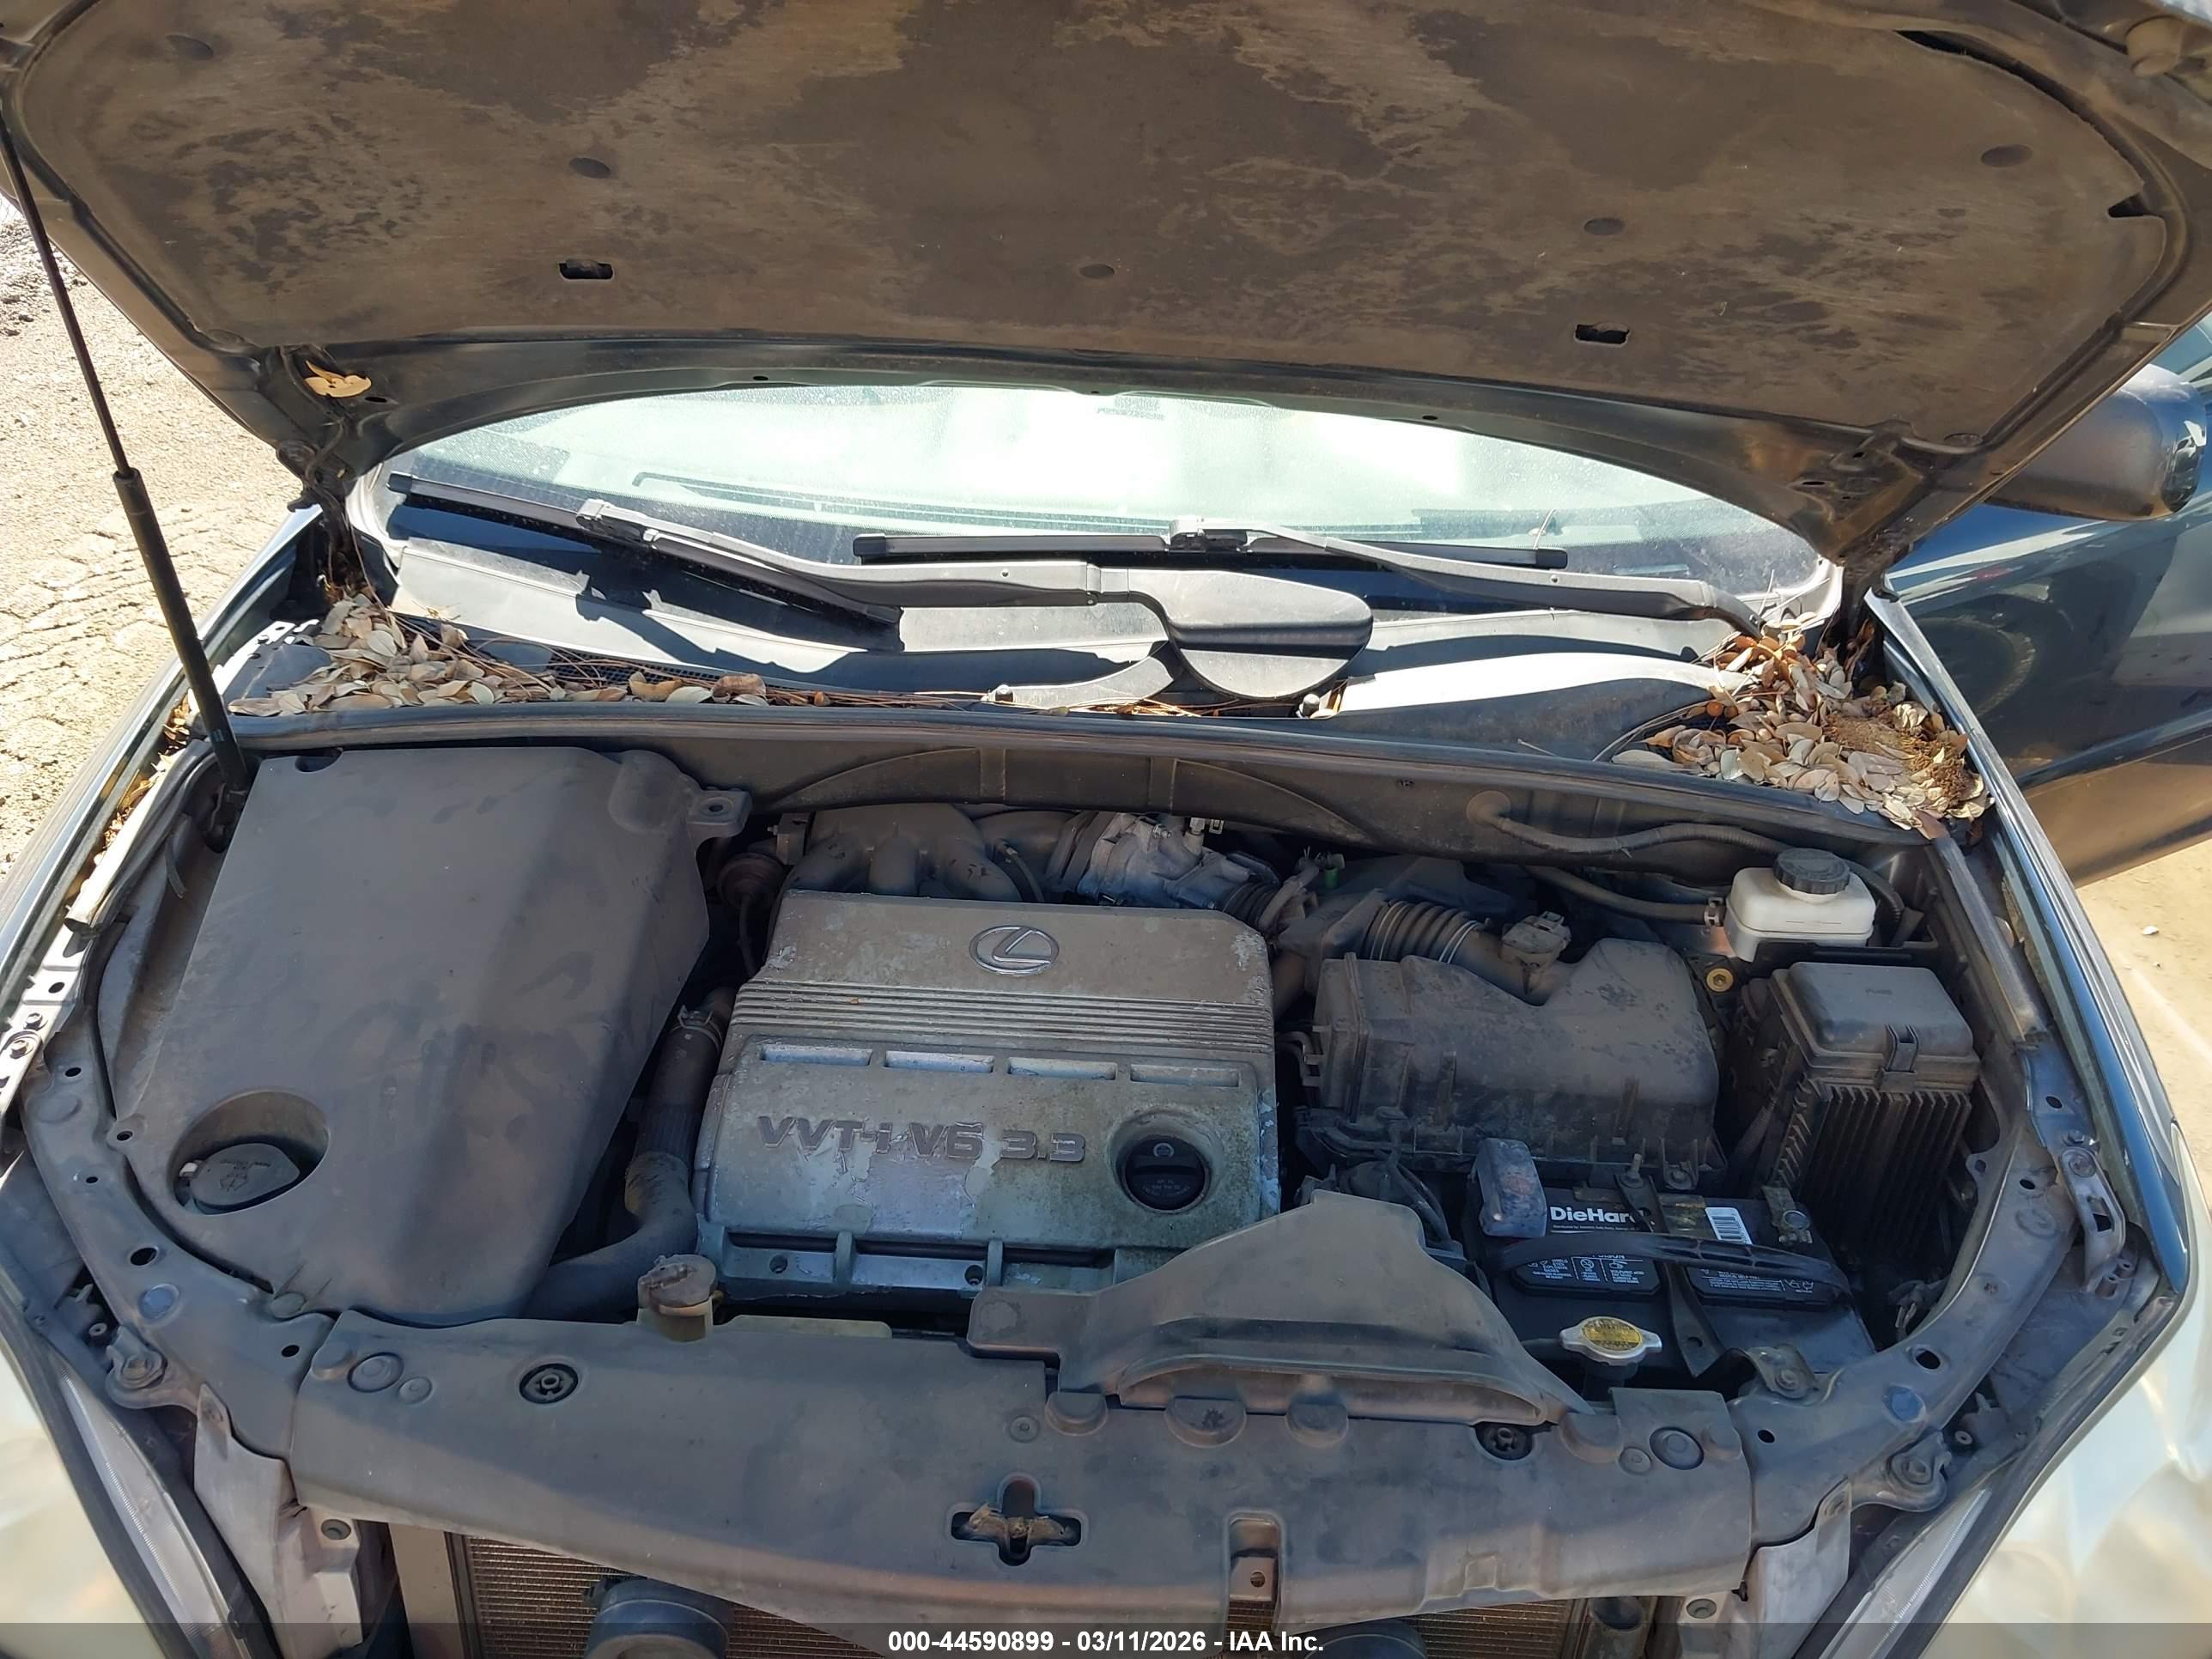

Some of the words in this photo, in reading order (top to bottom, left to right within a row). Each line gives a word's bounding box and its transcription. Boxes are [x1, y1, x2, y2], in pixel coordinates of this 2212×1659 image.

[757, 1116, 893, 1155] VVT-i
[908, 1121, 984, 1160] V6
[1000, 1129, 1086, 1163] 3.3
